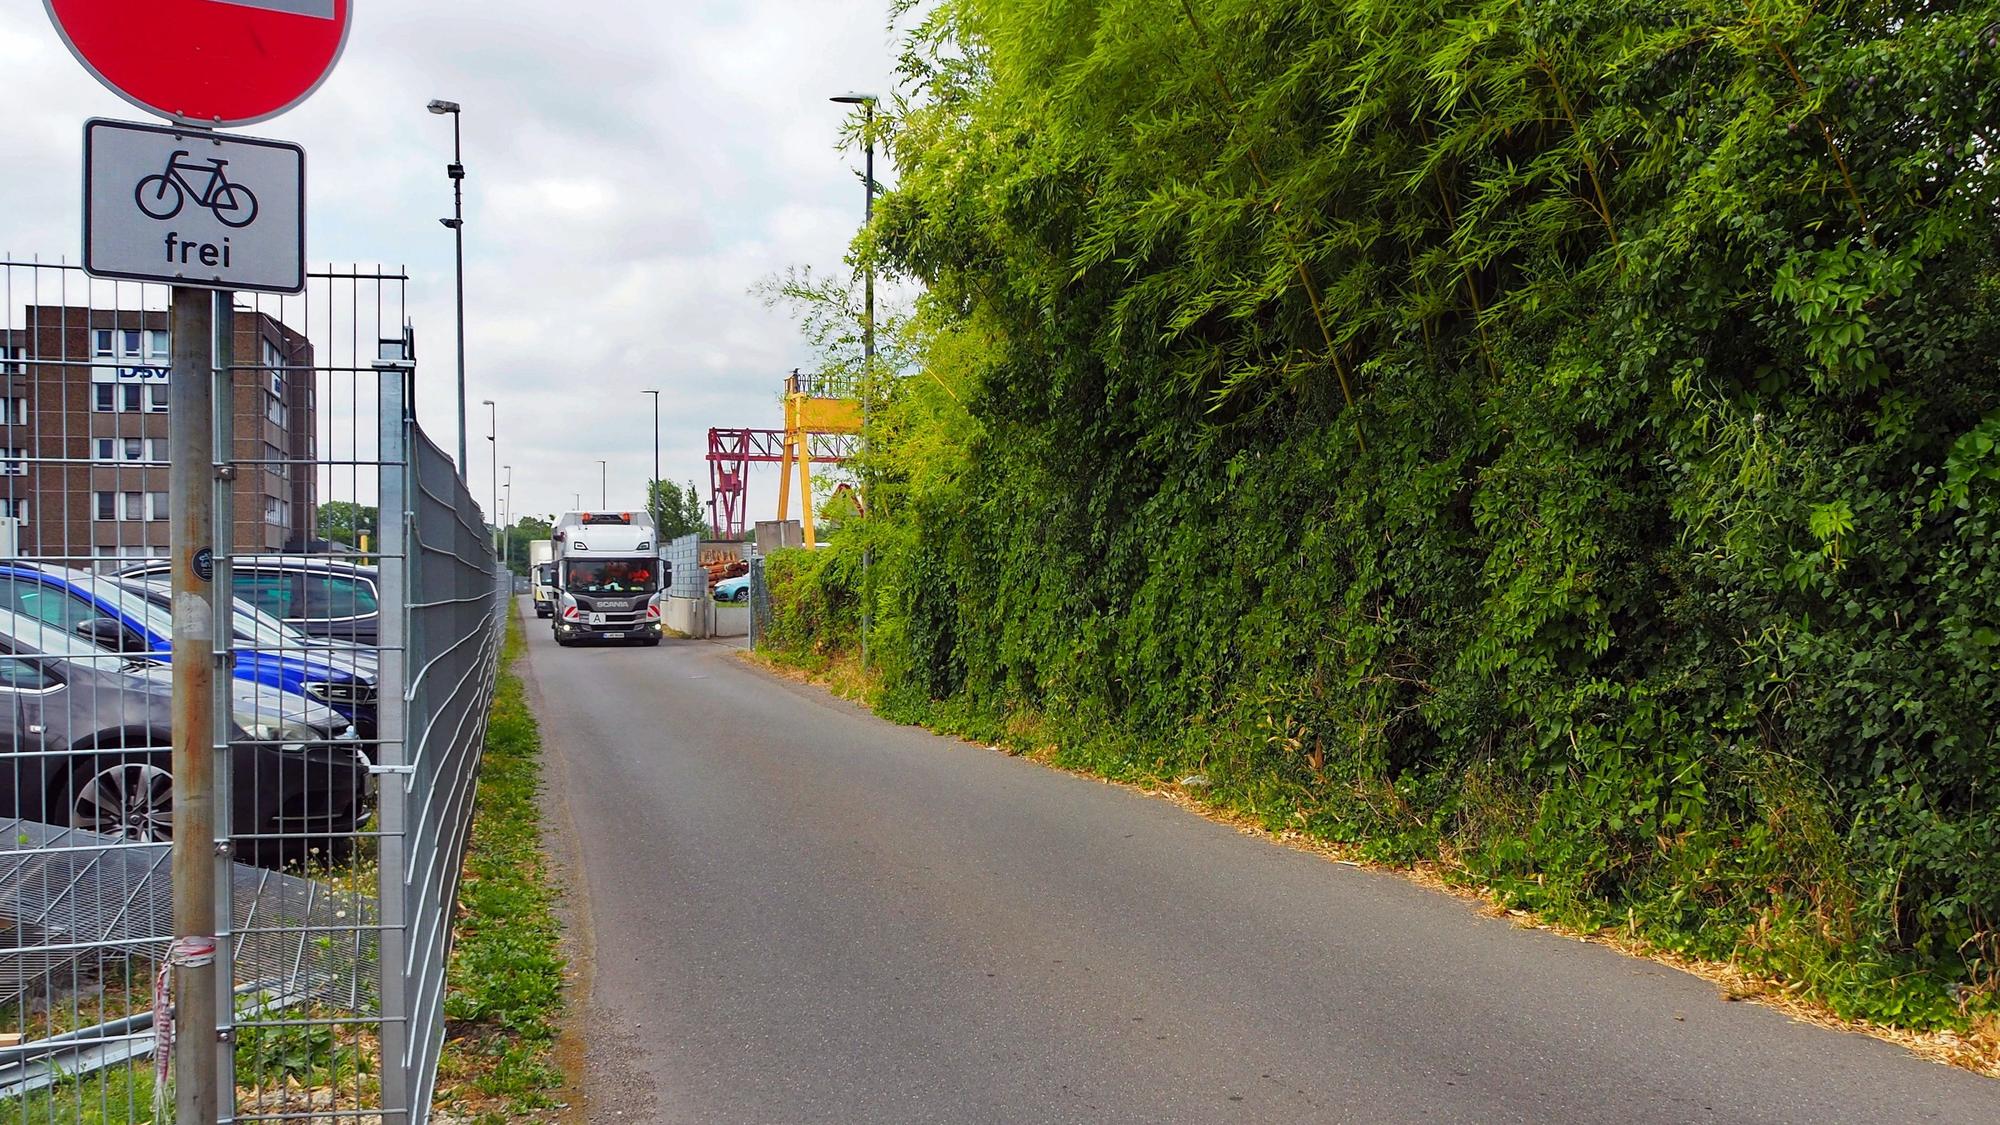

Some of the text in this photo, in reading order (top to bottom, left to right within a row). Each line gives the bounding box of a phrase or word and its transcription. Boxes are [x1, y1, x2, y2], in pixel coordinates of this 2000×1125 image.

[165, 232, 230, 268] frei
[120, 364, 170, 378] DSV
[594, 614, 602, 623] A
